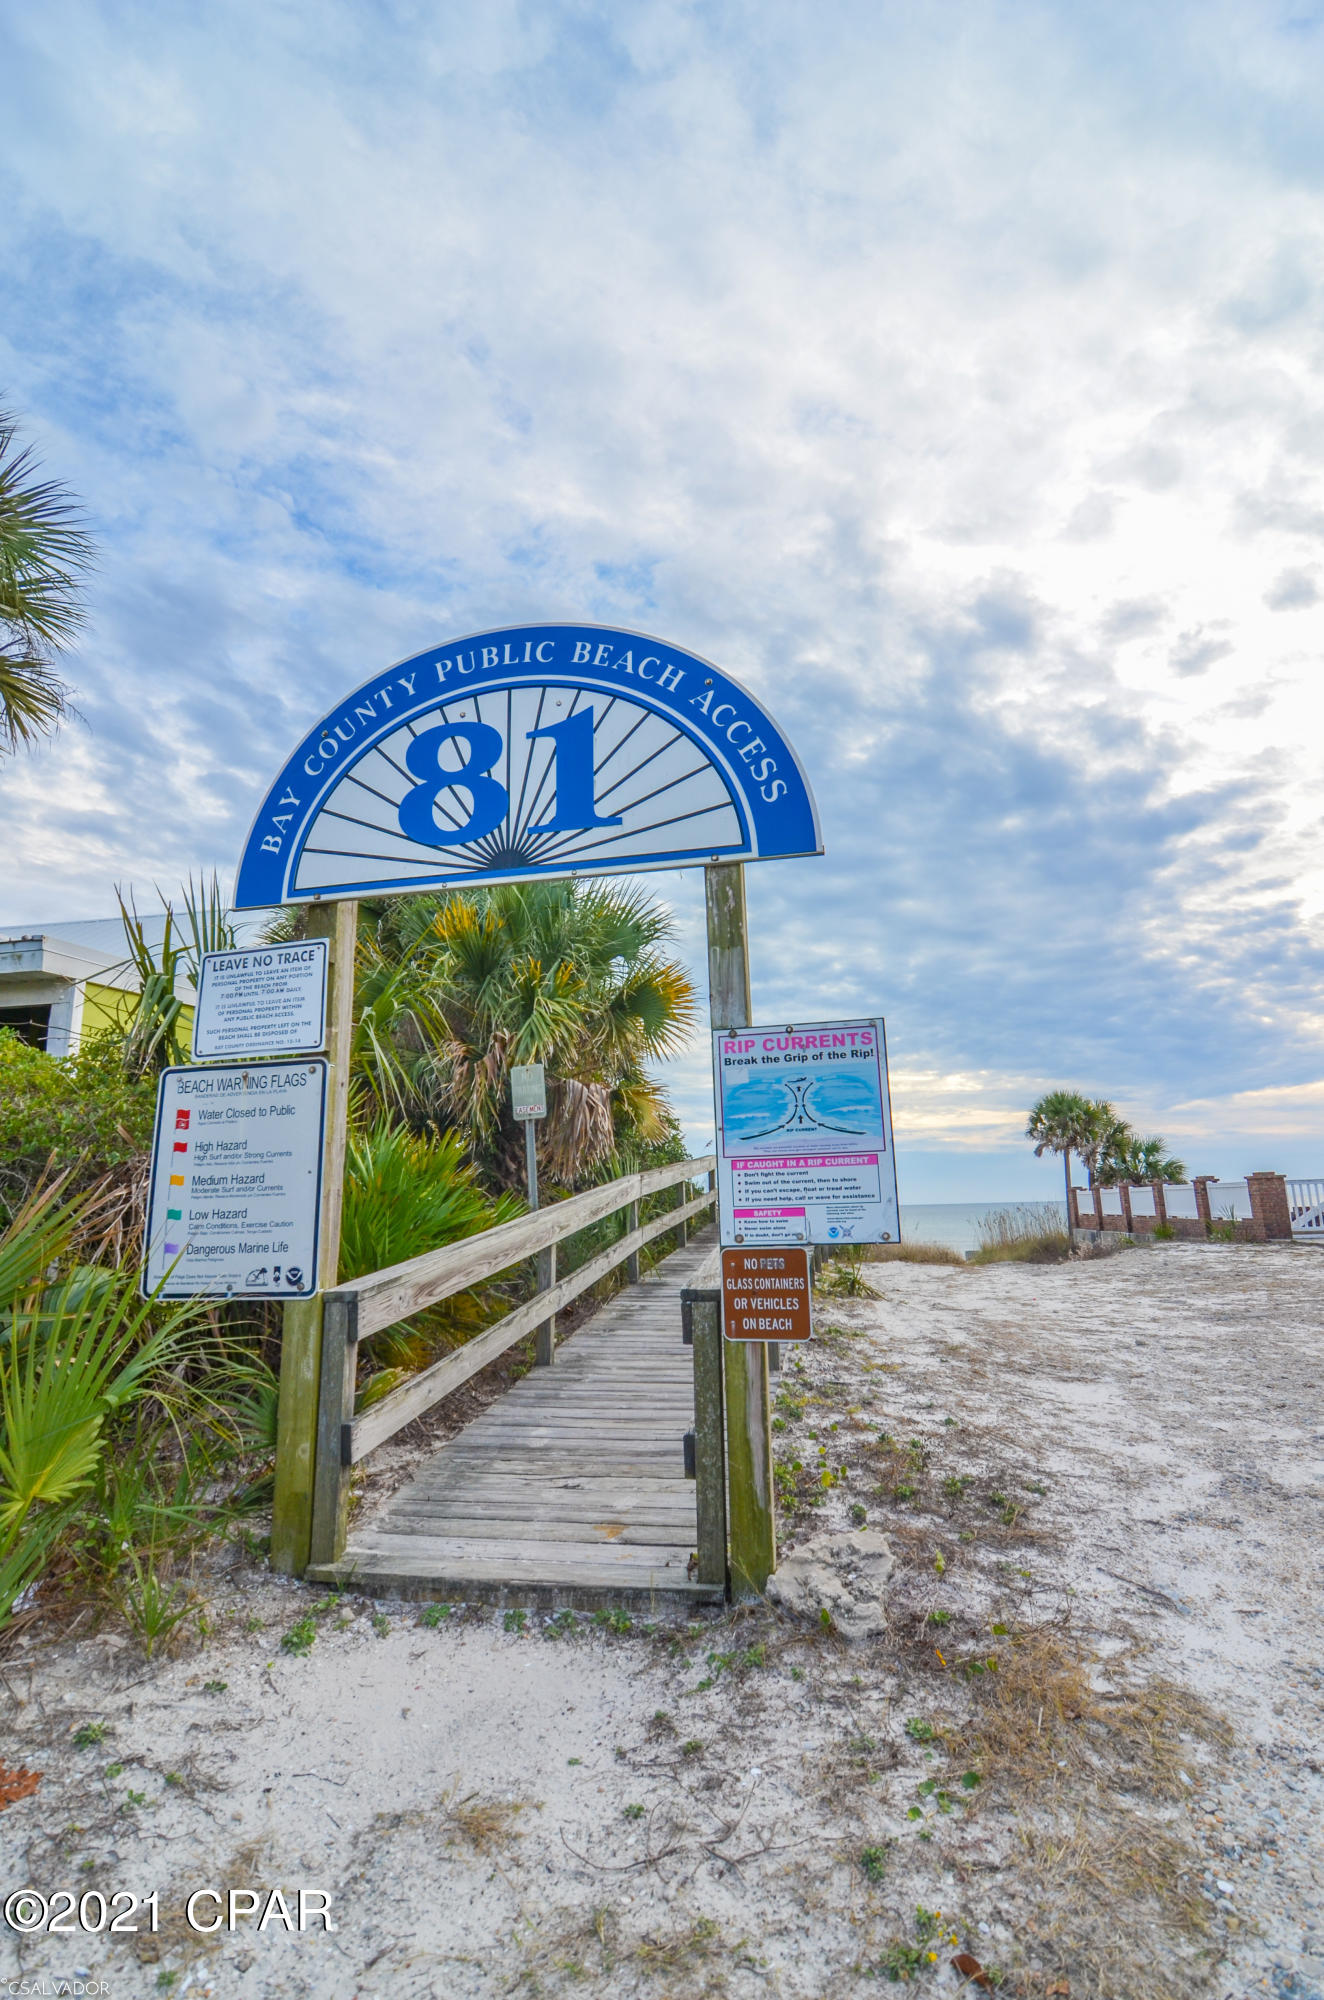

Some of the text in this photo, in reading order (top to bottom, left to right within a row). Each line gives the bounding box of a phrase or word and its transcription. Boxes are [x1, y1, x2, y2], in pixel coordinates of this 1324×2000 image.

[260, 641, 788, 855] BAY COUNTY PUBLIC BEACH ACCESS
[398, 705, 623, 846] 81
[213, 950, 315, 972] LEAVE NO TRACE
[724, 1032, 873, 1054] RIP CURRENTS
[724, 1048, 874, 1066] Break the Grip of the Rip!
[177, 1079, 213, 1094] BEACH
[271, 1073, 306, 1087] FLAGS
[198, 1105, 295, 1120] Water Closed to Public
[195, 1140, 247, 1154] High Hazard
[747, 1160, 784, 1168] CAUGHT
[825, 1157, 869, 1165] CURRENT
[192, 1172, 265, 1186] Medium Hazard
[189, 1208, 247, 1220] Low Hazard
[187, 1241, 288, 1257] Dangerous Marine Life
[744, 1258, 785, 1269] NO PETS
[727, 1278, 804, 1289] GLASS CONTAINERS
[734, 1298, 799, 1310] OR VEHICLES
[743, 1318, 792, 1330] ON BEACH
